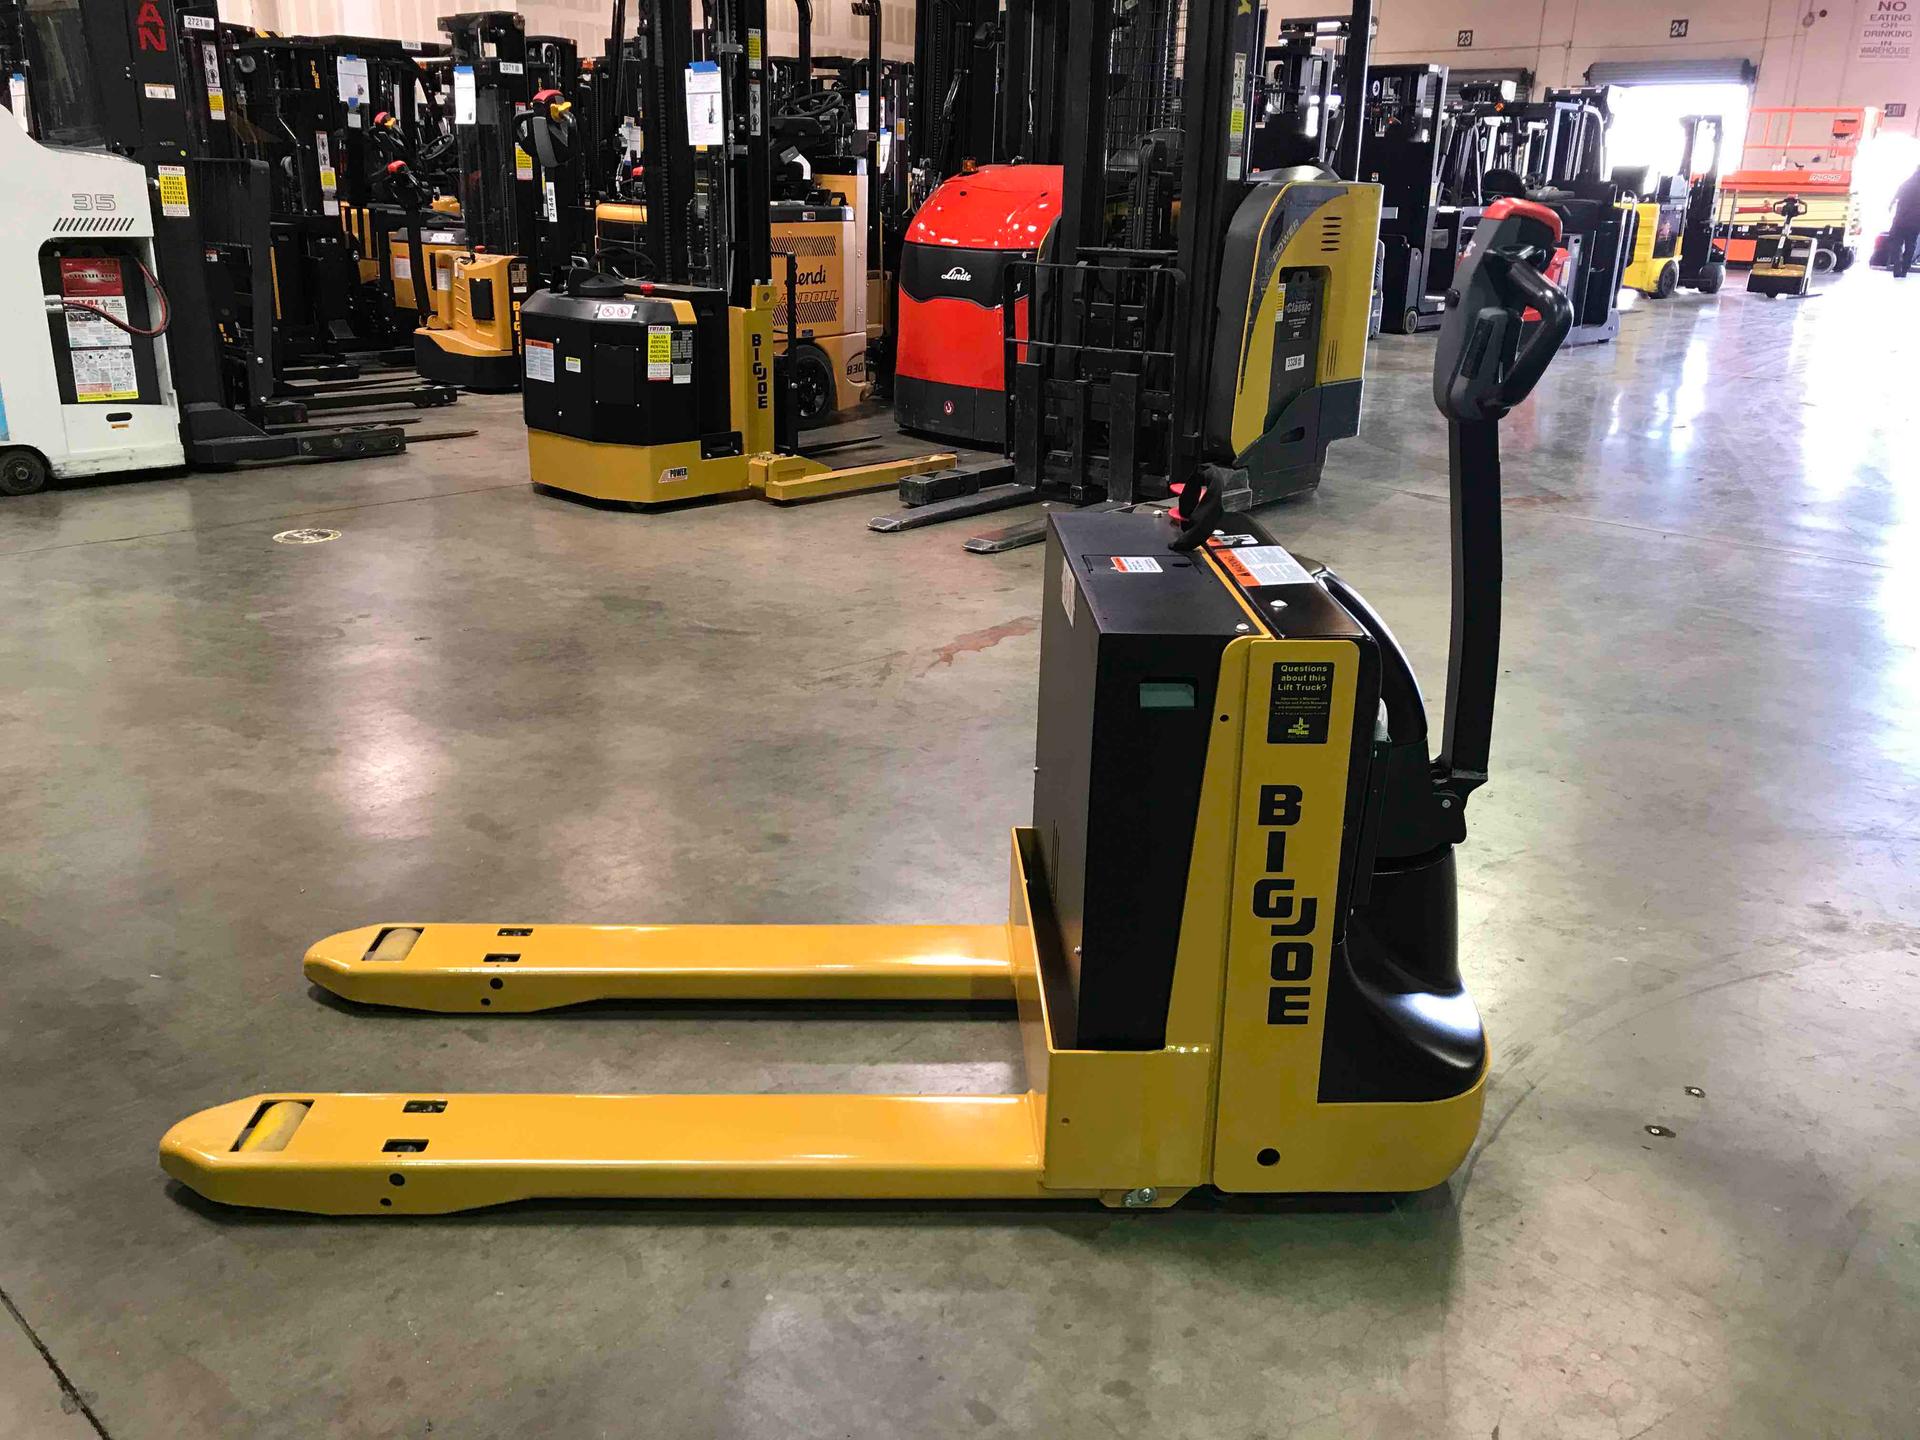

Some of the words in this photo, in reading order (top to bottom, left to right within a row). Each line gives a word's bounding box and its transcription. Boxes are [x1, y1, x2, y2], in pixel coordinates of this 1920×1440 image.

[1878, 1, 1906, 11] NO
[136, 0, 167, 51] AN
[1671, 22, 1686, 36] 24
[1459, 32, 1471, 45] 23
[72, 193, 116, 211] 35
[1272, 219, 1299, 261] POWER
[941, 267, 972, 281] Linde
